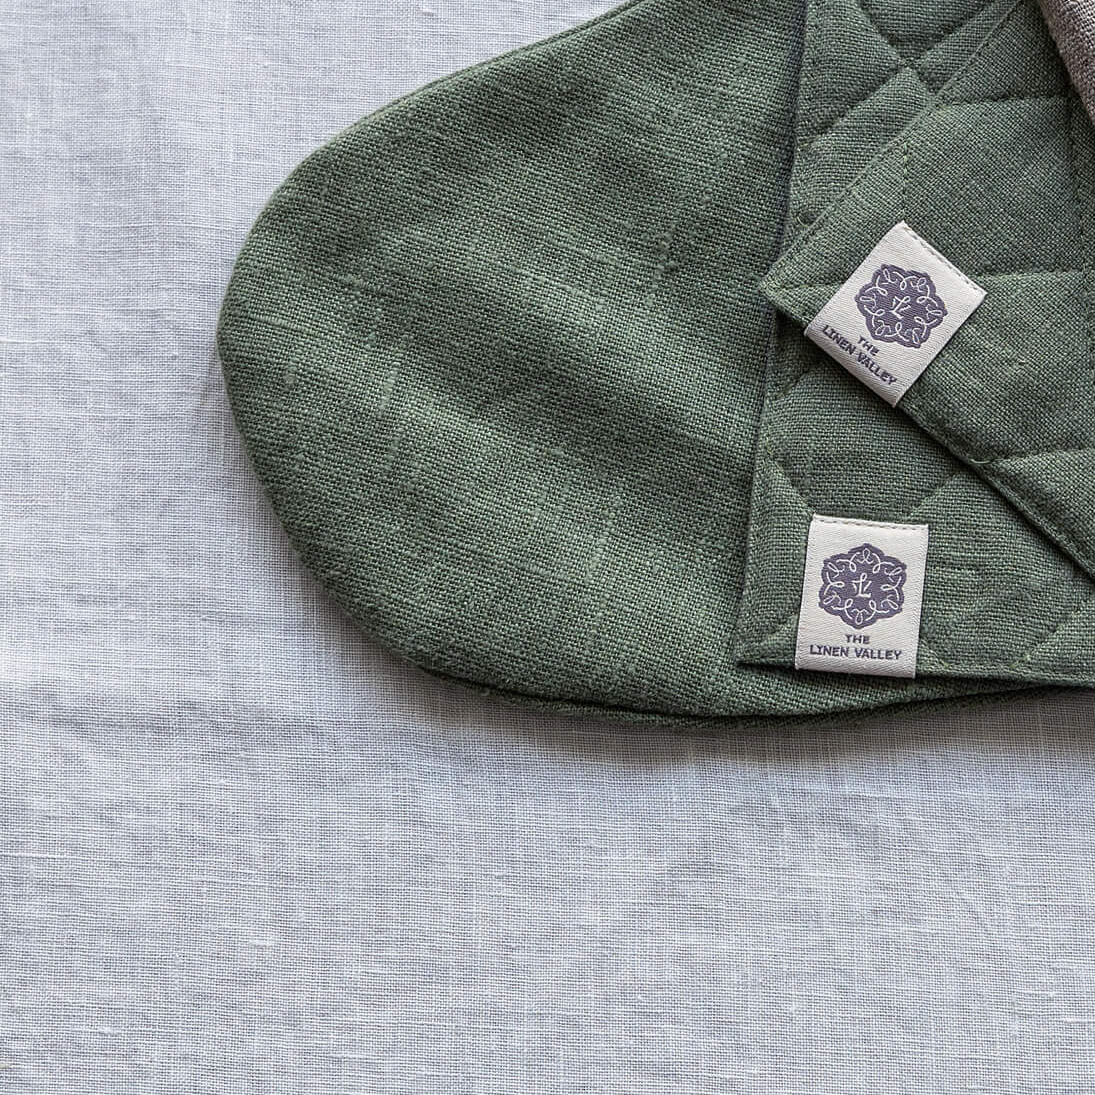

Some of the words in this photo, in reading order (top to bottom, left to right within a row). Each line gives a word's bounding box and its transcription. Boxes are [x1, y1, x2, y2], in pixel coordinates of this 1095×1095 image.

[822, 325, 857, 355] LINEN
[857, 352, 898, 385] VALLEY
[858, 336, 880, 356] THE
[845, 634, 870, 645] THE
[809, 644, 849, 657] LINEN
[854, 647, 902, 660] VALLEY
